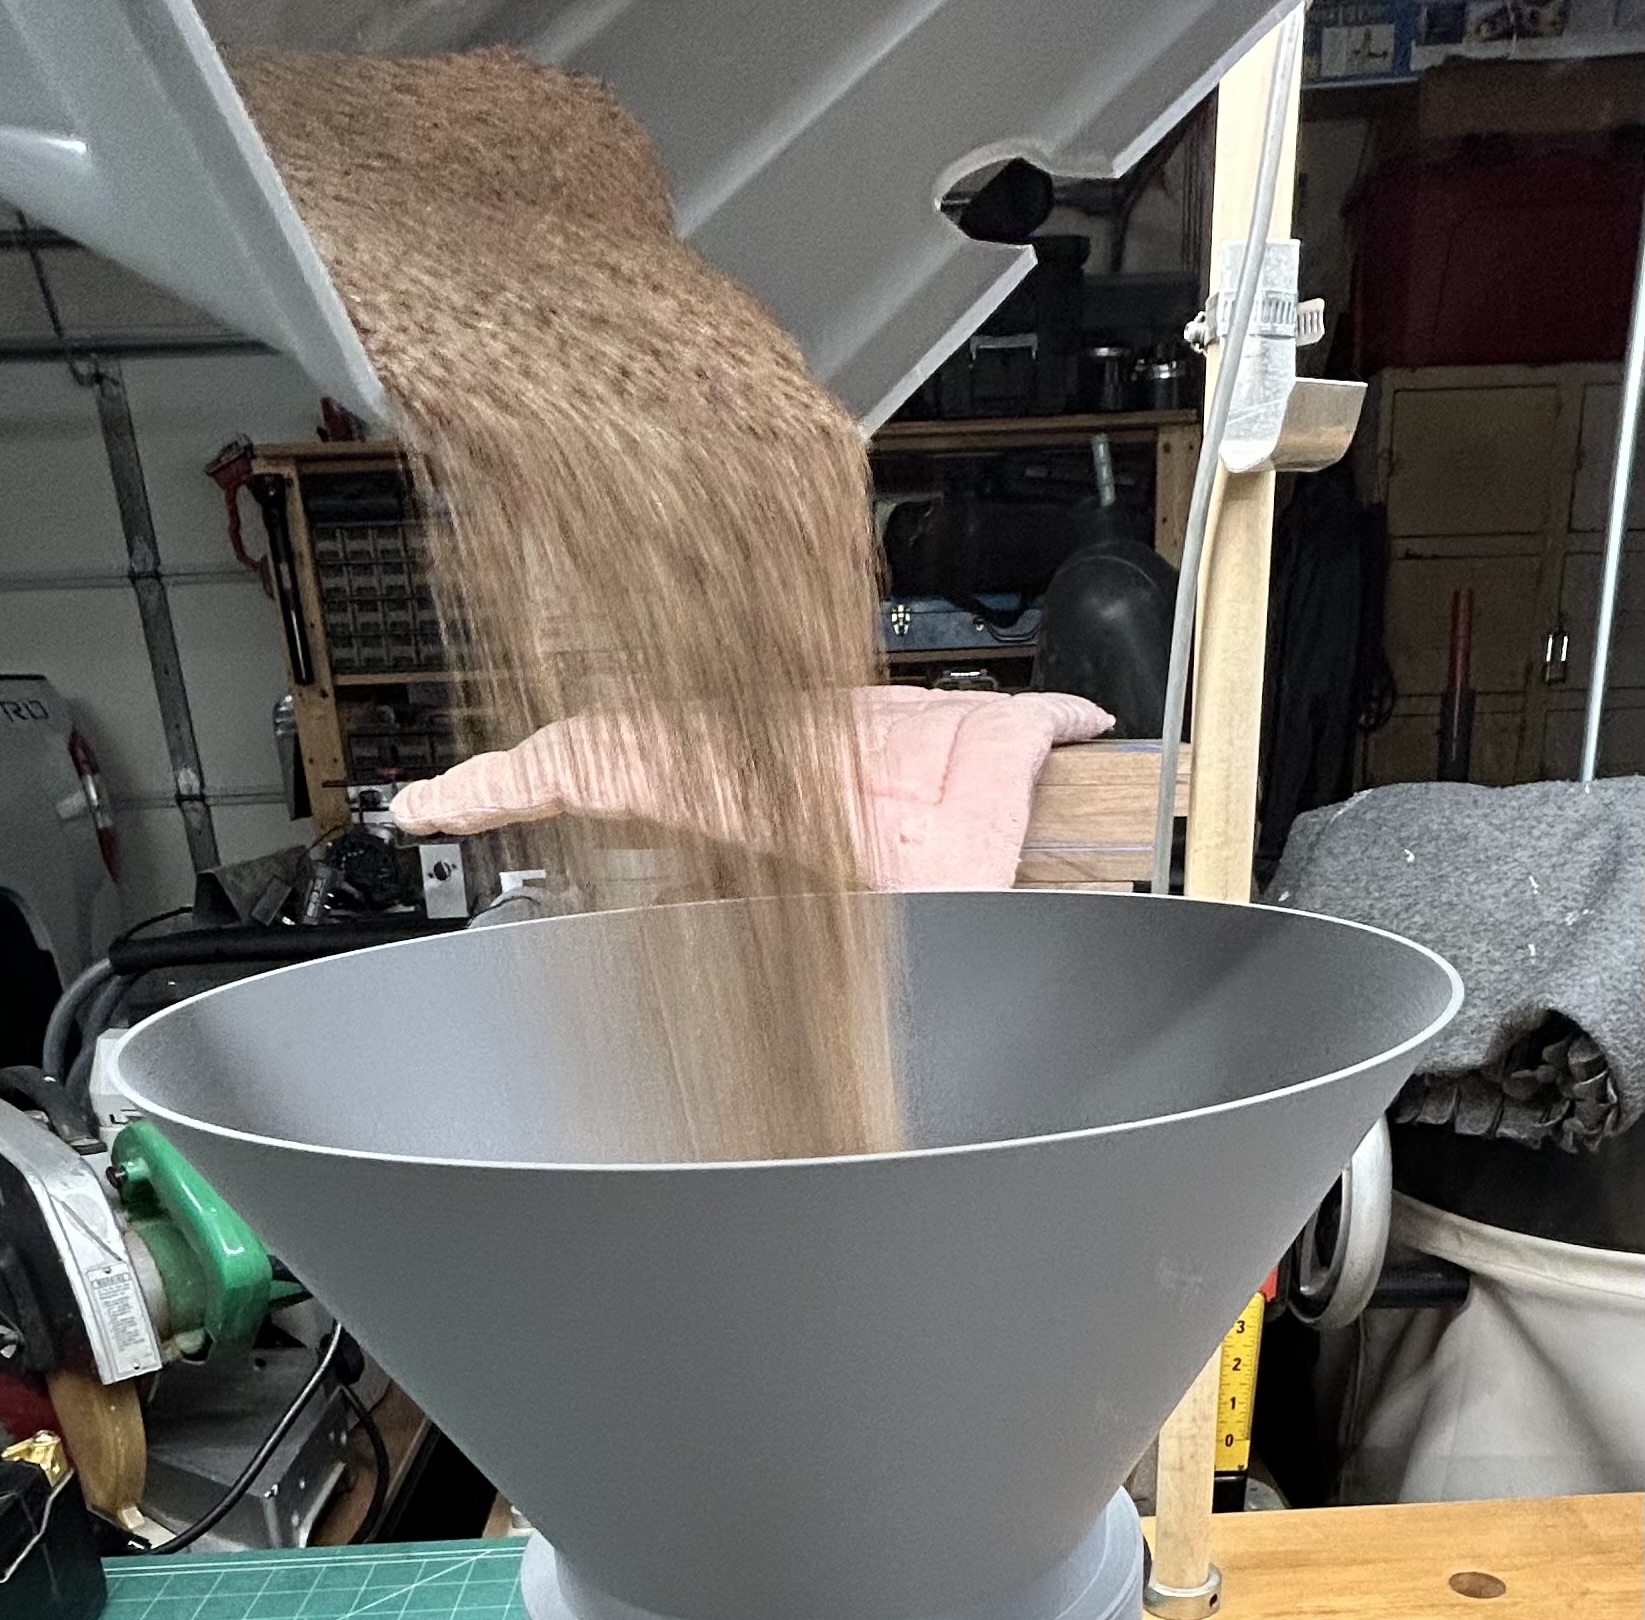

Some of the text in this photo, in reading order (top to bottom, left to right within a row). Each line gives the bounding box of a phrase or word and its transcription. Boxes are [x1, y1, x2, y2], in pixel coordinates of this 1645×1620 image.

[1236, 1320, 1246, 1334] 3
[1232, 1357, 1242, 1372] 2
[1229, 1396, 1237, 1411] 1
[1225, 1433, 1235, 1448] 0
